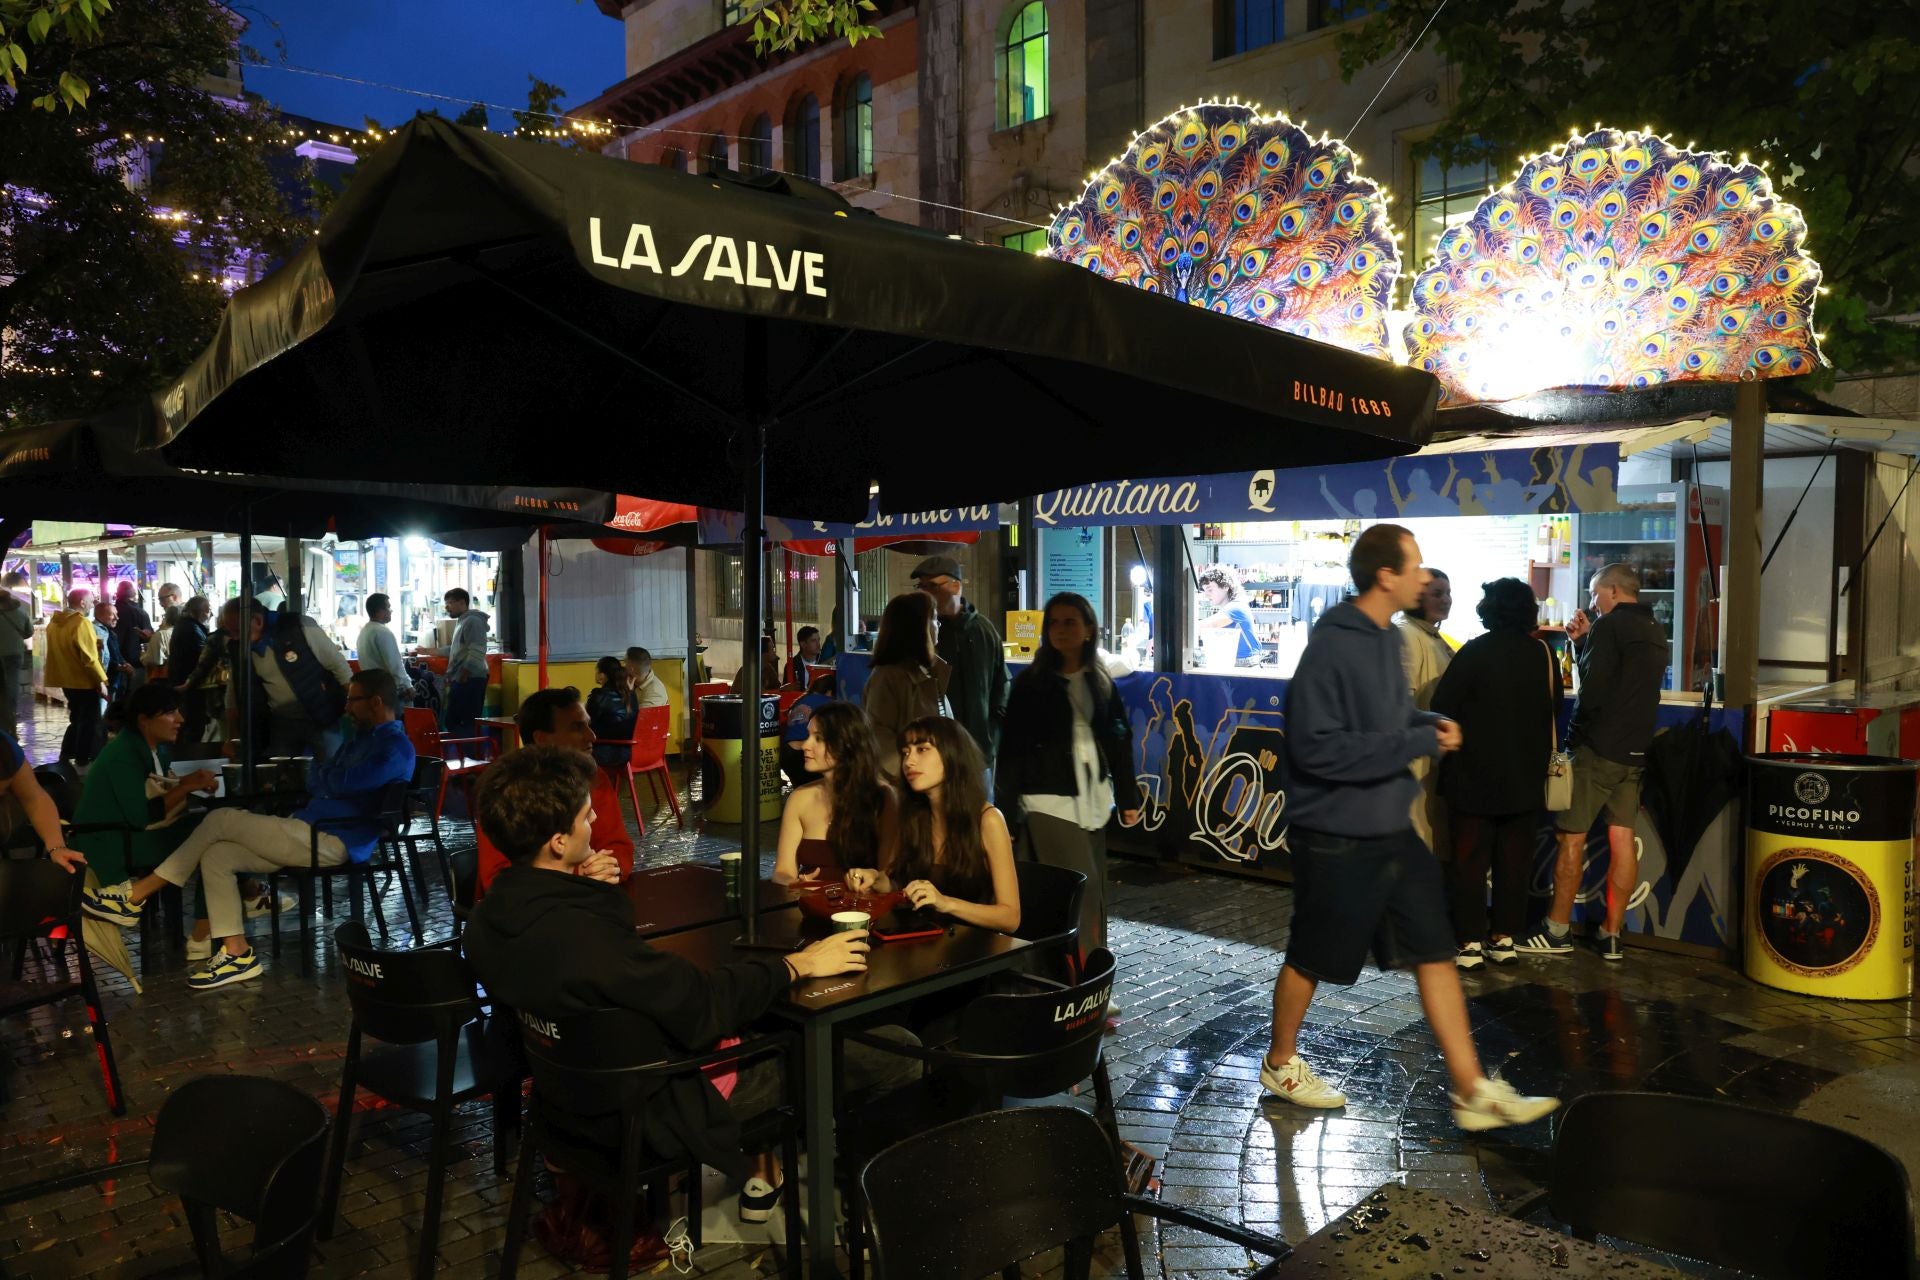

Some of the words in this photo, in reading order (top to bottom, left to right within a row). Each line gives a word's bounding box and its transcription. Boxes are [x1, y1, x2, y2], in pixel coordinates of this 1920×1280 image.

[590, 217, 663, 274] LA
[670, 234, 827, 297] SALVE
[1294, 381, 1343, 412] BILBAO
[1351, 397, 1391, 417] 1886
[514, 495, 549, 509] BILBAO
[553, 501, 579, 511] 1886
[1034, 479, 1200, 525] Quintana
[1769, 804, 1860, 823] PICOFINO
[1782, 820, 1815, 829] VERMUT
[350, 957, 385, 980] SALVE
[1054, 1002, 1075, 1023] LA
[1075, 983, 1111, 1017] SALVE
